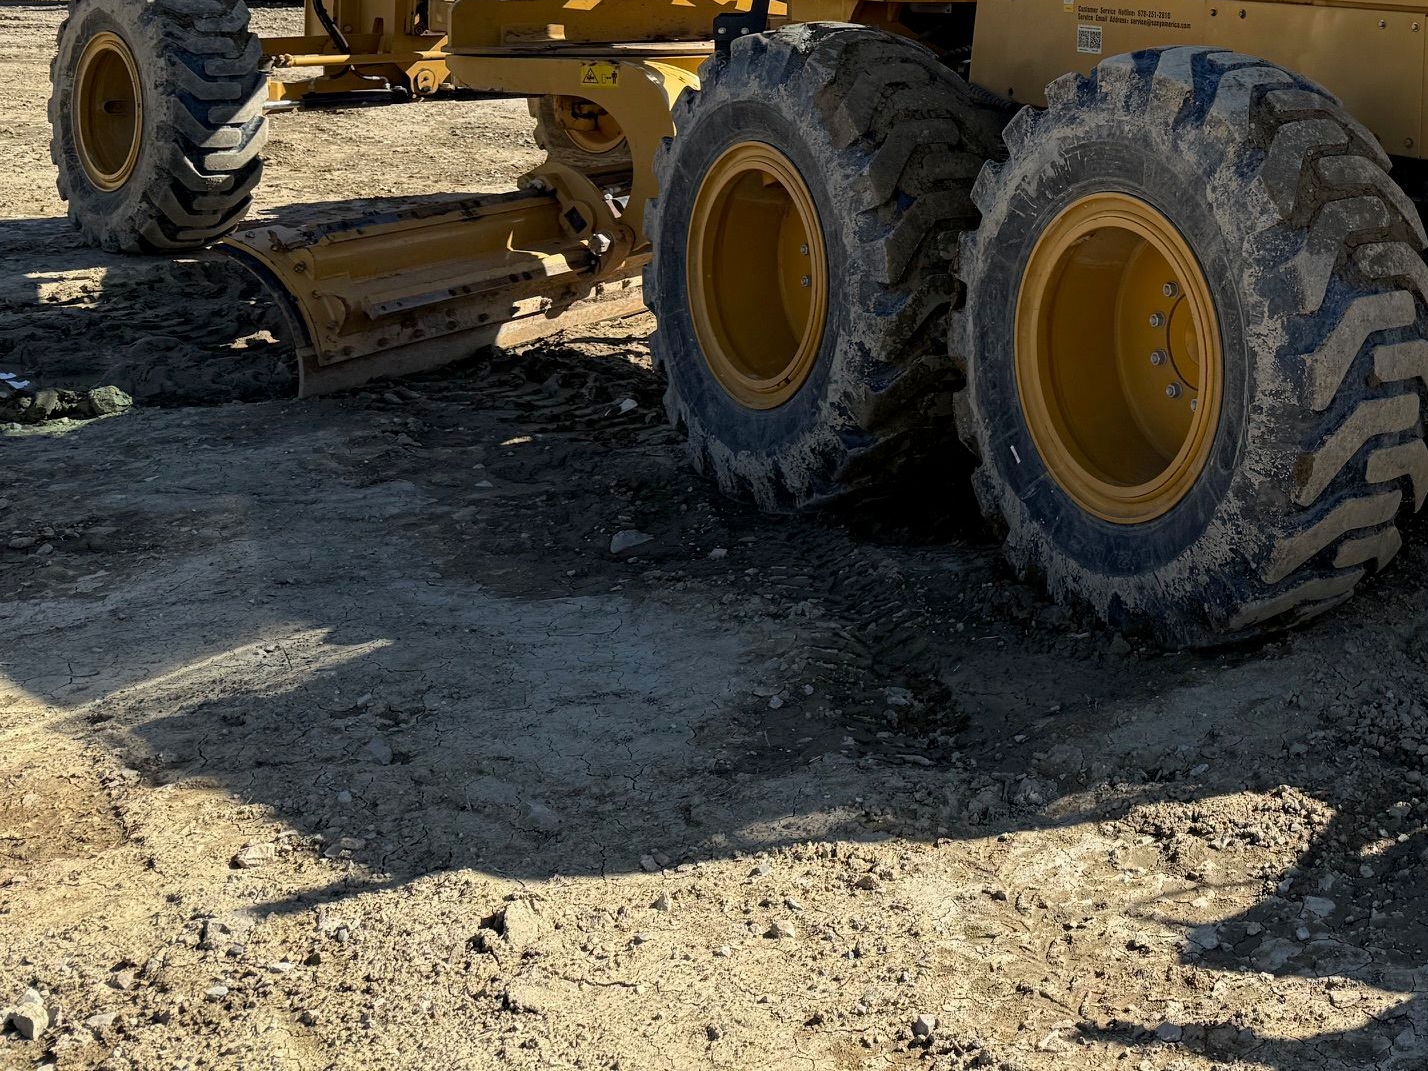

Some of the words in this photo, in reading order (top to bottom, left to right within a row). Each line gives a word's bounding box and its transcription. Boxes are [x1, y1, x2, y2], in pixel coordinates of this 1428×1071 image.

[1077, 5, 1098, 14] Customer
[1100, 7, 1116, 16] Service
[1077, 13, 1094, 21] Service
[1095, 14, 1108, 23] Email
